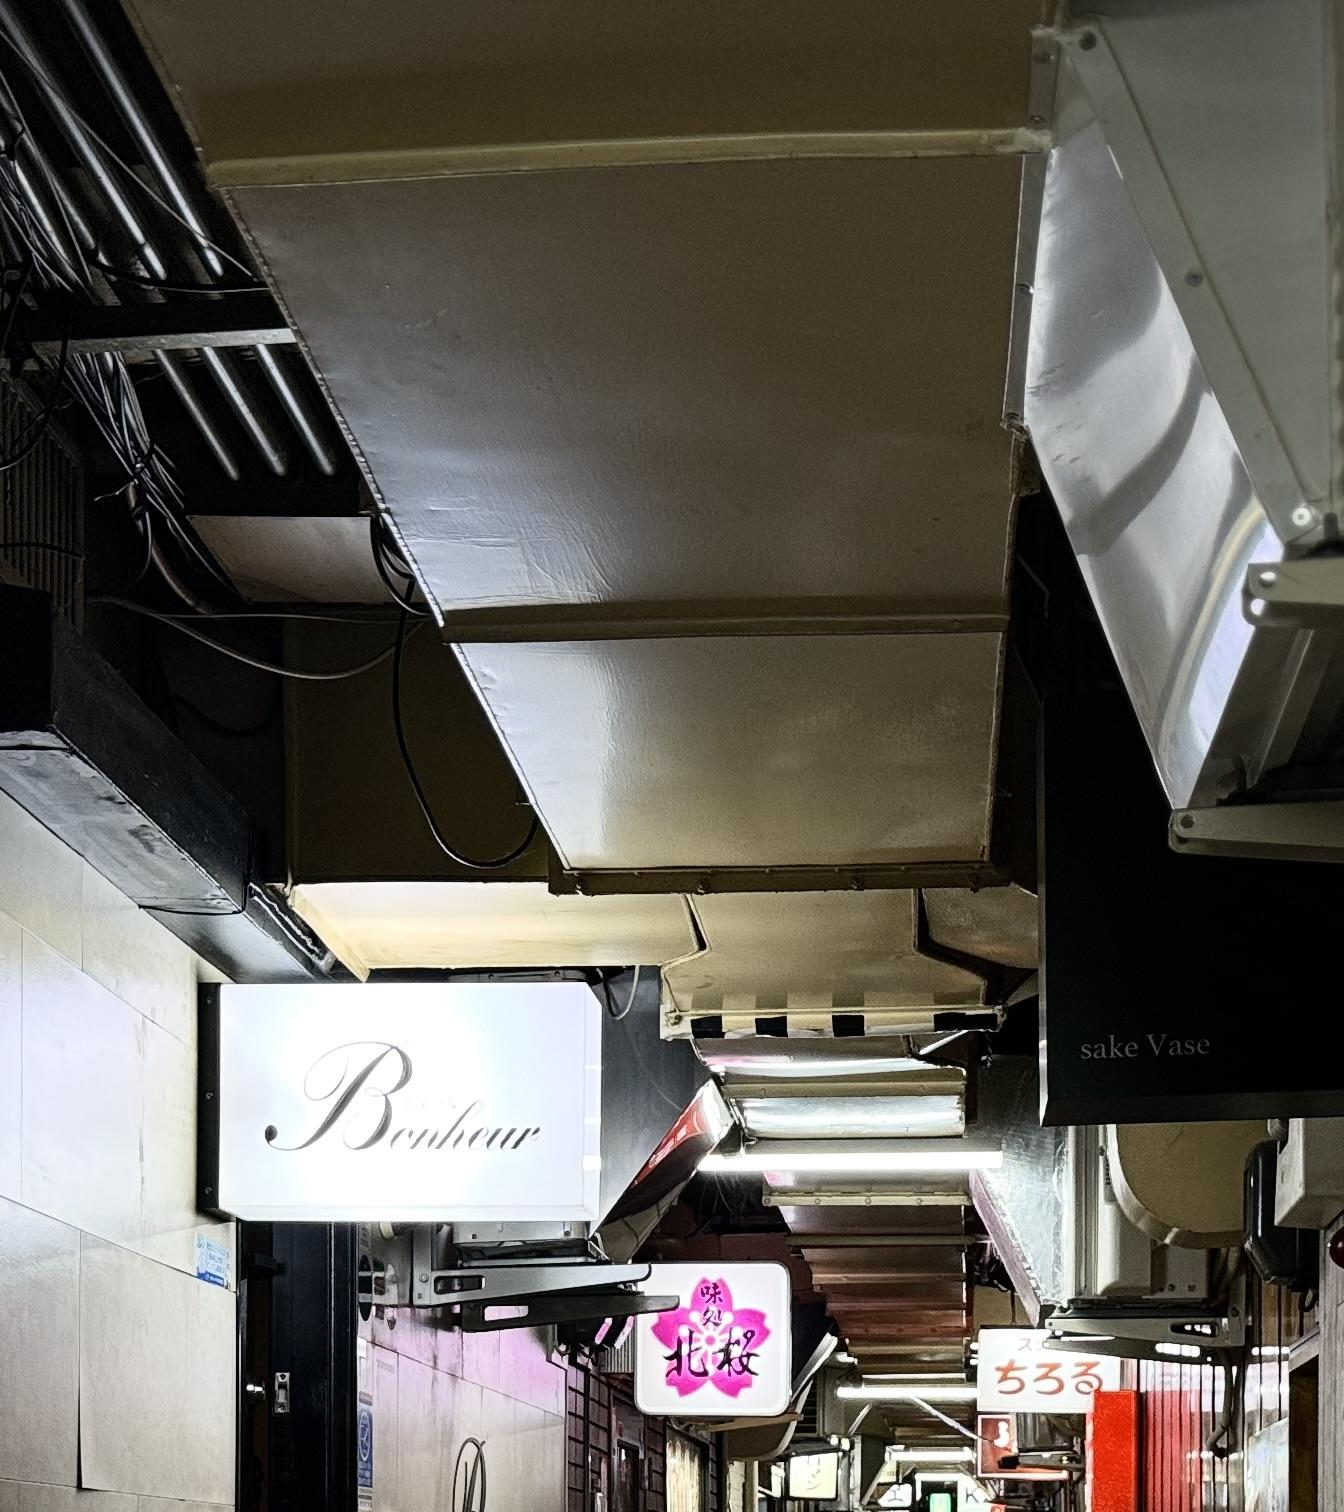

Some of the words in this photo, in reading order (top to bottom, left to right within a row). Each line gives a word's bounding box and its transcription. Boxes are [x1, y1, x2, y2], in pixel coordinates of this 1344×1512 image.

[1080, 1034, 1139, 1061] sake
[1146, 1033, 1211, 1057] Vase
[264, 1041, 542, 1151] Bonheur
[994, 1358, 1103, 1395] ちろる
